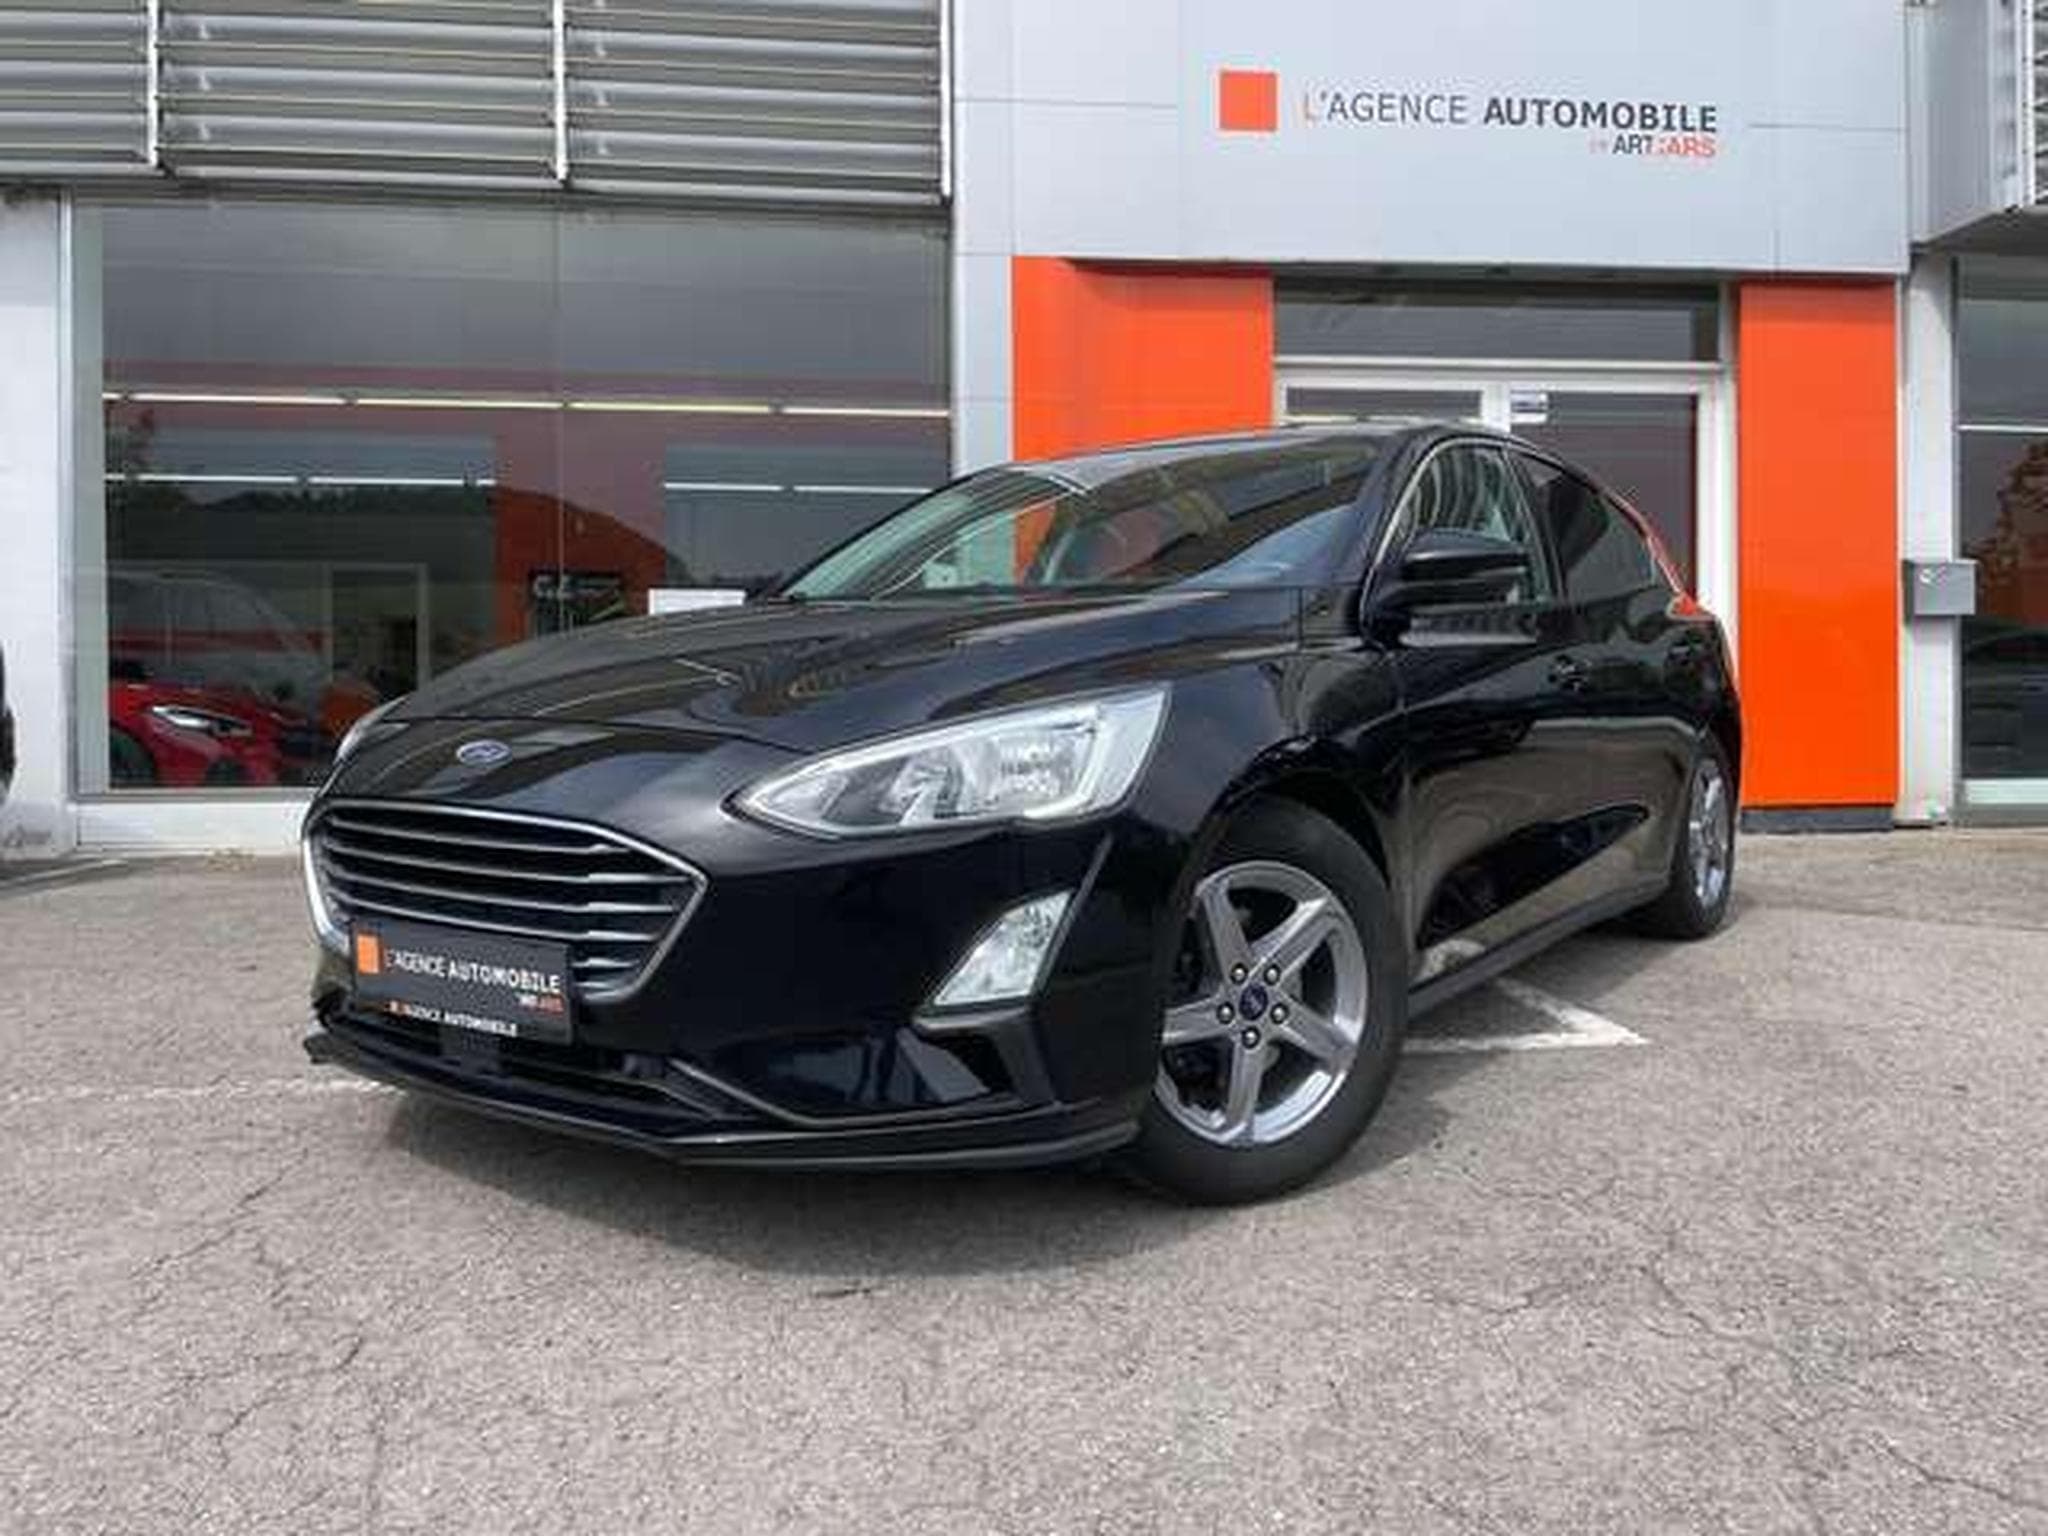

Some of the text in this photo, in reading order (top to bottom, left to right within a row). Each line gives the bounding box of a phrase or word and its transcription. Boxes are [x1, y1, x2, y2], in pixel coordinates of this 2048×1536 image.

[1303, 90, 1717, 133] L'AGENCE AUTOMOBILE
[449, 960, 561, 994] AUTOMOBILE
